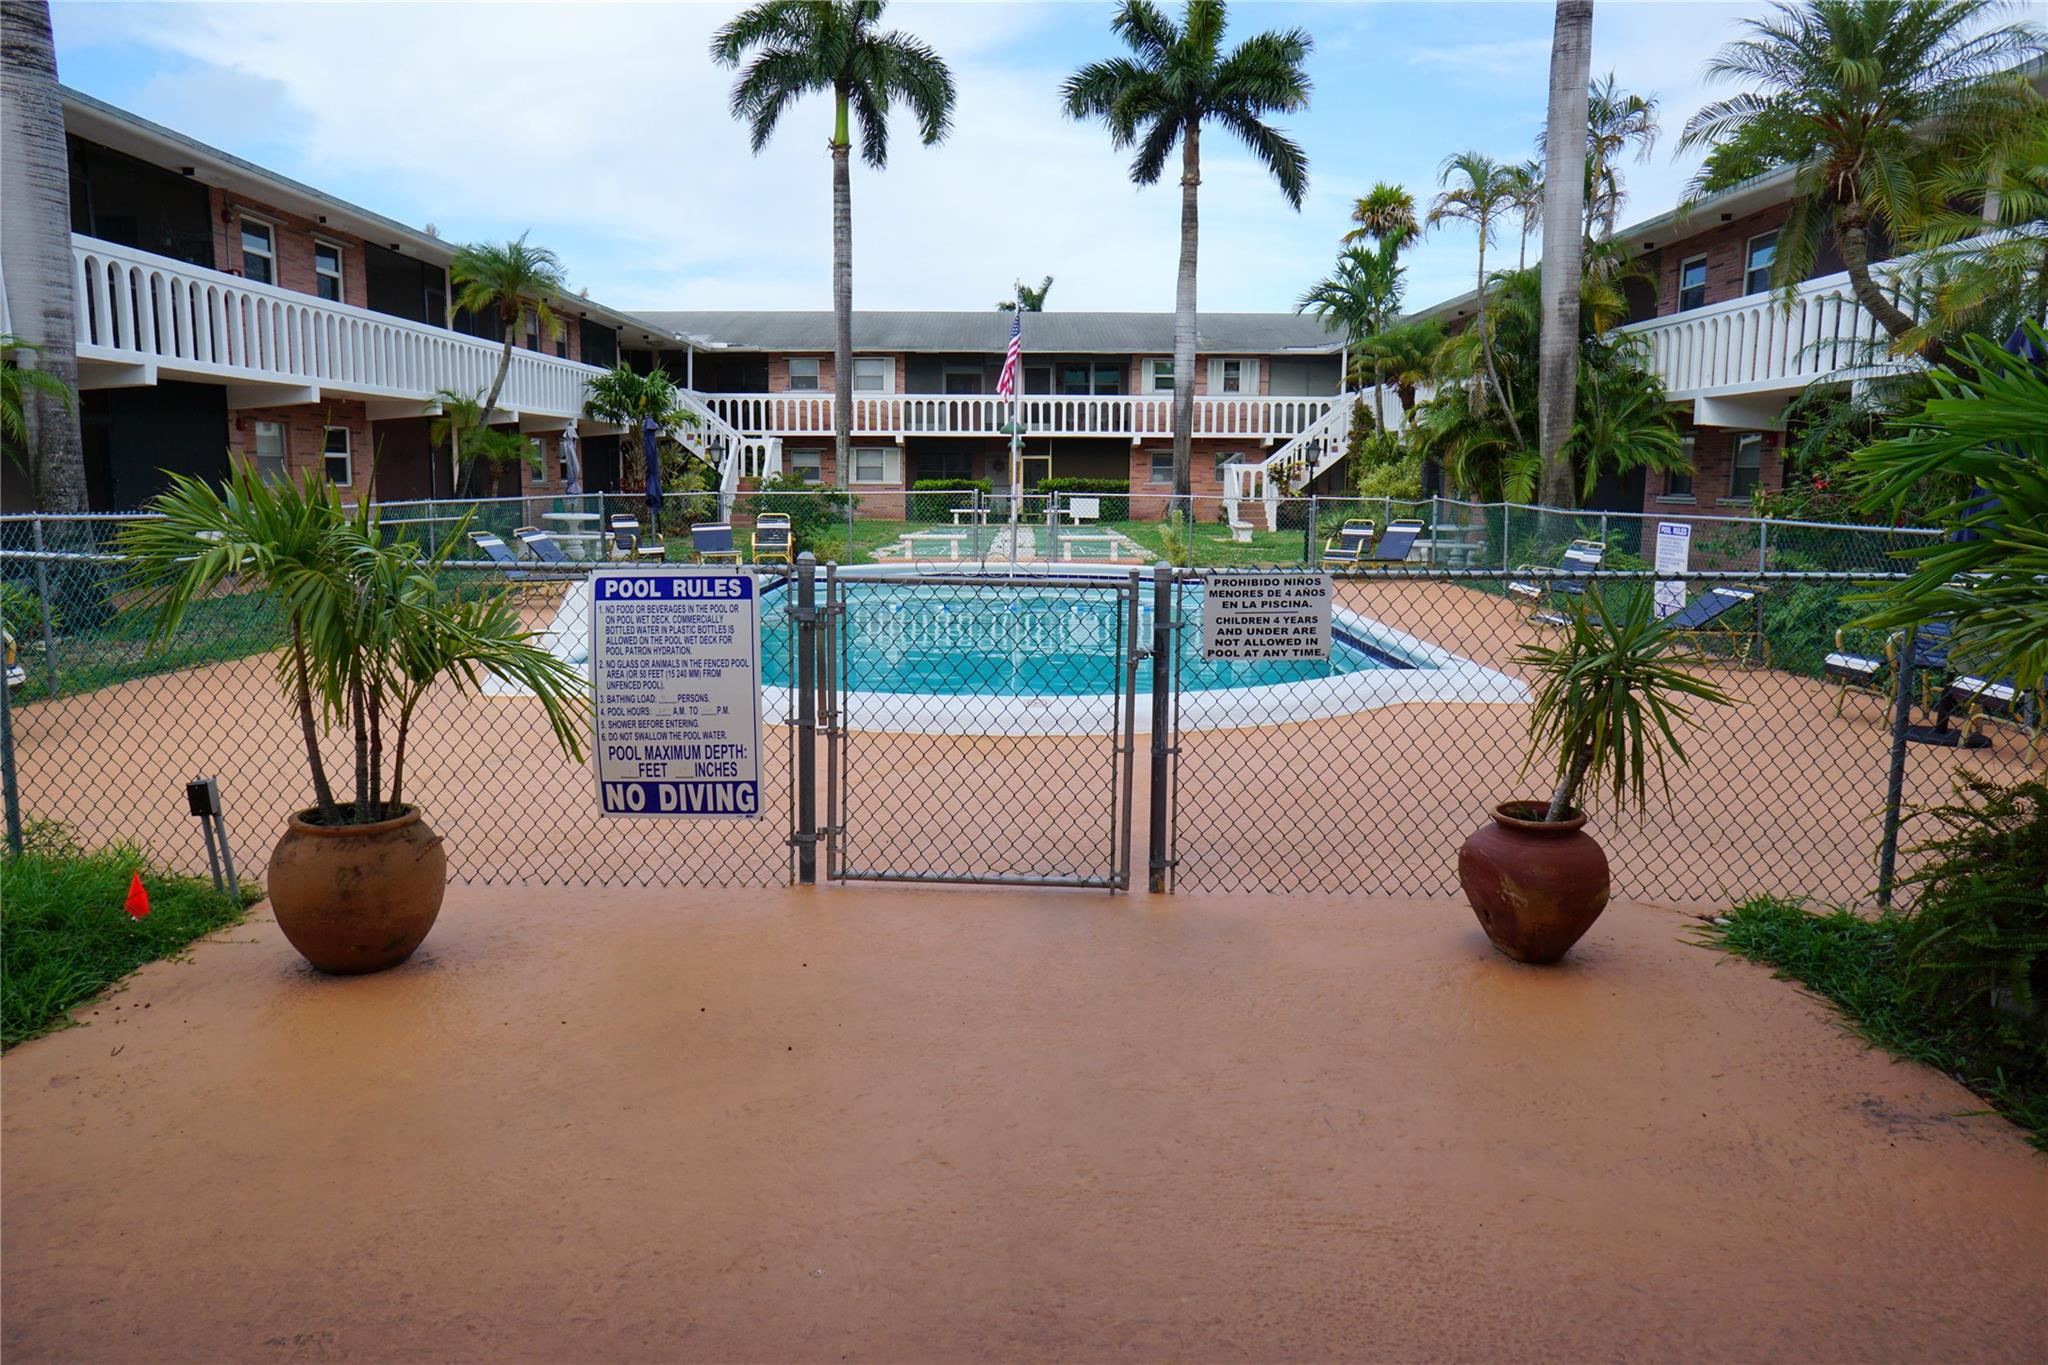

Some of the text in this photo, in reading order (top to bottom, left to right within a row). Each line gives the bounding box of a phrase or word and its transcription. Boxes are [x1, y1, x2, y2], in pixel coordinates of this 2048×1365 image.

[1214, 577, 1321, 586] PROHIBIDO NIÑOS
[605, 578, 742, 598] POOL RULES
[1294, 588, 1326, 596] AÑOS
[1261, 600, 1312, 608] PISCINA.
[606, 605, 615, 614] NO
[616, 605, 634, 614] FOOD
[636, 605, 645, 614] OR
[647, 604, 686, 614] BEVERAGES
[688, 604, 694, 613] IN
[696, 604, 708, 613] THE
[710, 604, 728, 613] POOL
[729, 604, 739, 613] OR
[606, 616, 615, 624] ON
[616, 616, 634, 624] POOL
[636, 616, 650, 624] WET
[672, 615, 724, 624] COMMERCIALLY
[606, 625, 734, 634] BOTTLED WATER IN PLASTIC BOTTLES IS
[606, 636, 732, 645] ALLOWED ON THE POOL WET DECK FOR
[606, 647, 624, 656] POOL
[625, 647, 652, 656] PATRON
[1292, 648, 1324, 656] TIME.
[606, 660, 616, 668] NO
[617, 660, 638, 668] GLASS
[640, 660, 650, 668] OR
[652, 660, 680, 668] ANIMALS
[682, 660, 688, 668] IN
[690, 659, 702, 668] THE
[704, 659, 729, 668] FENCED
[731, 658, 749, 668] POOL
[607, 670, 624, 678] AREA
[648, 670, 664, 678] FEET
[703, 669, 721, 678] FROM
[606, 681, 641, 690] UNFENCED
[607, 694, 636, 704] BATHING
[608, 708, 625, 716] POOL
[689, 706, 698, 715] TO
[608, 720, 636, 729] SHOWER
[638, 720, 664, 728] BEFORE
[608, 732, 618, 741] DO
[620, 732, 632, 740] NOT
[634, 732, 668, 740] SWALLOW
[669, 732, 682, 740] THE
[683, 731, 700, 740] POOL
[608, 744, 748, 760] POOL MAXIMUM DEPTH:
[638, 762, 738, 777] FEET INCHES
[605, 782, 754, 812] NO DIVING
